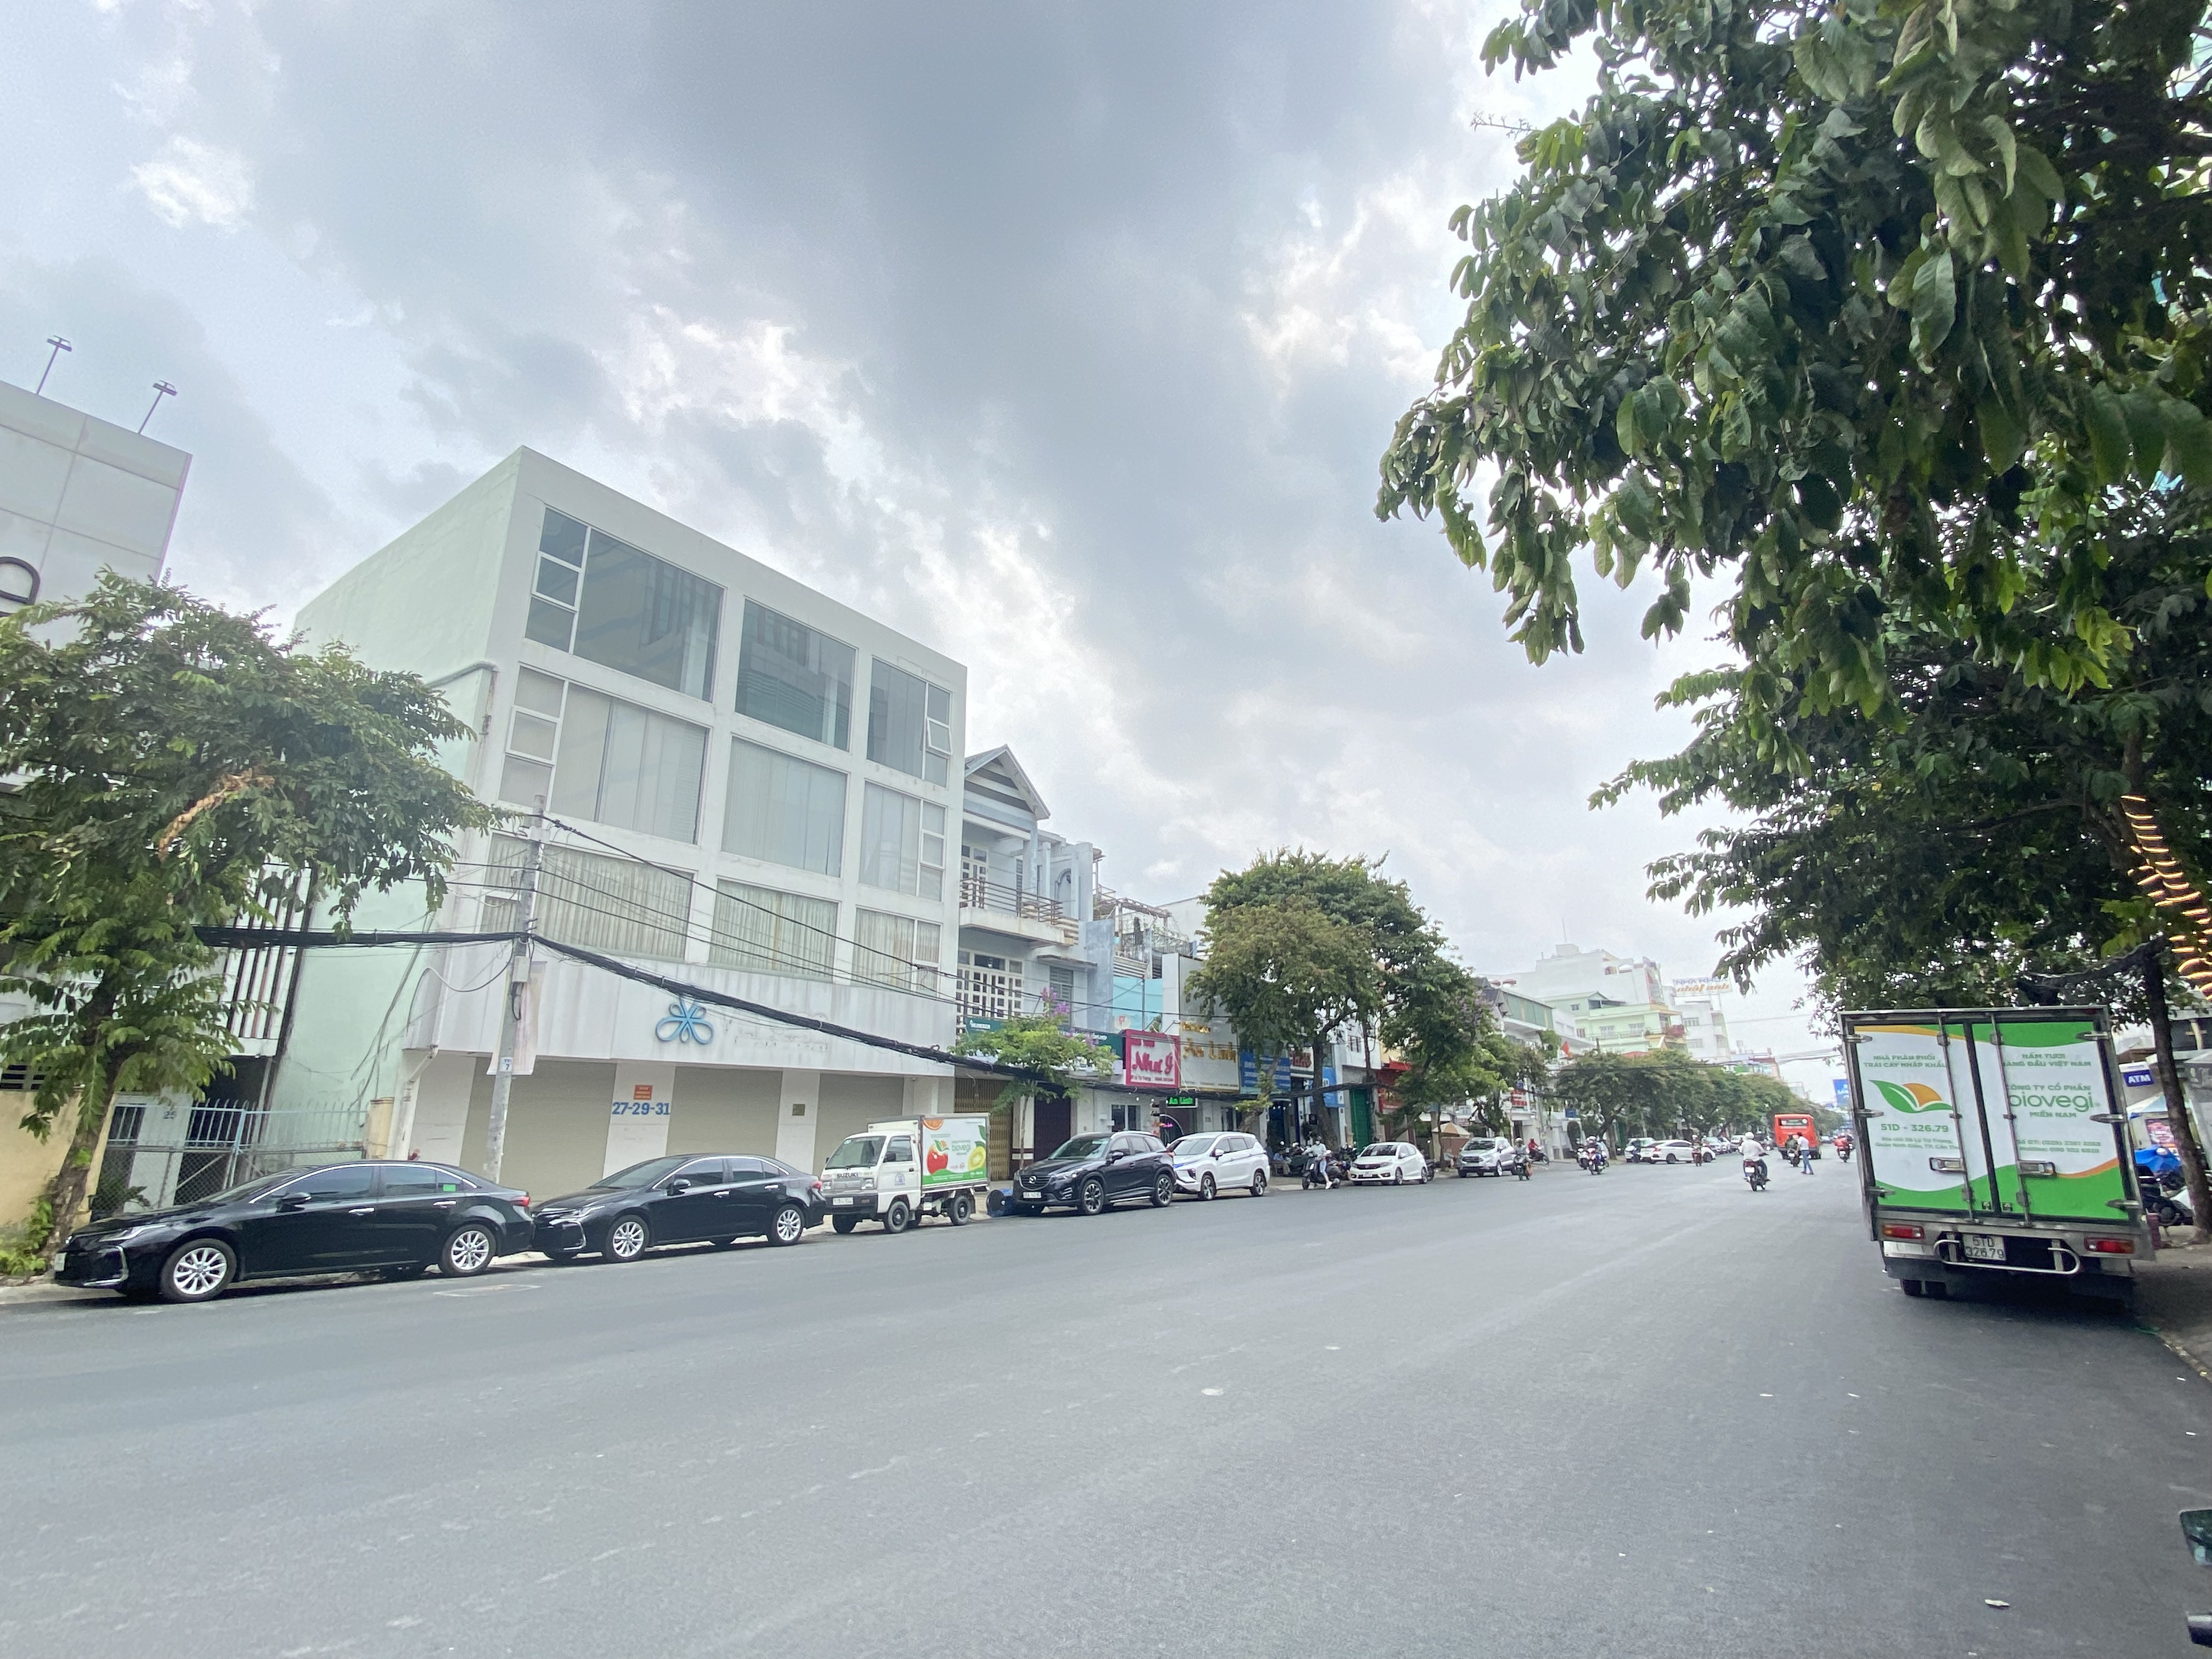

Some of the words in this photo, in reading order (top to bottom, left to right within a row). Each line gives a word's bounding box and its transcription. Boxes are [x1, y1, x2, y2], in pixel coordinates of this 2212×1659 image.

[1132, 1051, 1163, 1073] Như
[2129, 1074, 2151, 1084] ATM
[612, 1101, 670, 1115] 27-29-31
[1911, 1124, 1949, 1132] 326.79
[1972, 1235, 1995, 1247] 51D
[1965, 1246, 2005, 1259] 326.79
